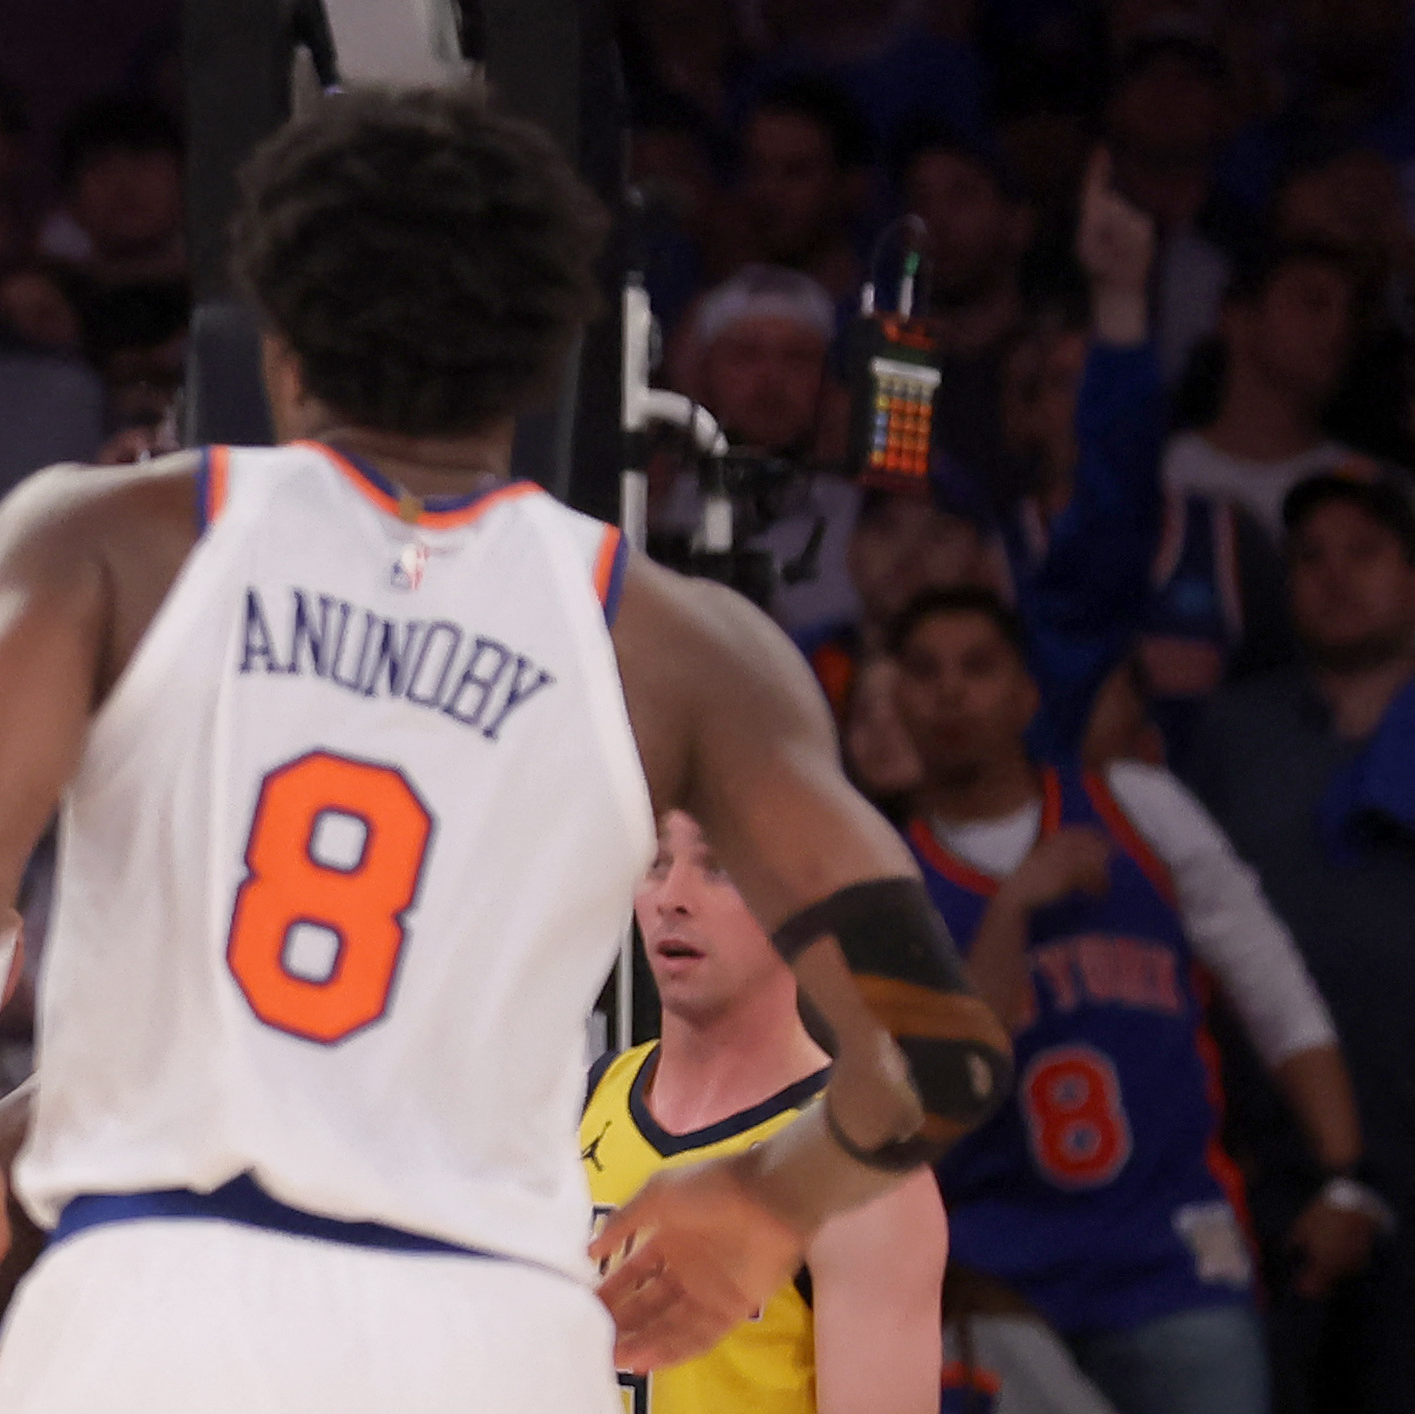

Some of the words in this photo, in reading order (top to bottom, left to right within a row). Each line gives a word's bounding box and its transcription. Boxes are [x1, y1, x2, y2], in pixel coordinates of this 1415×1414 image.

[239, 586, 557, 742] ANUNOBY
[226, 746, 438, 1047] 8
[1019, 1040, 1134, 1193] 8
